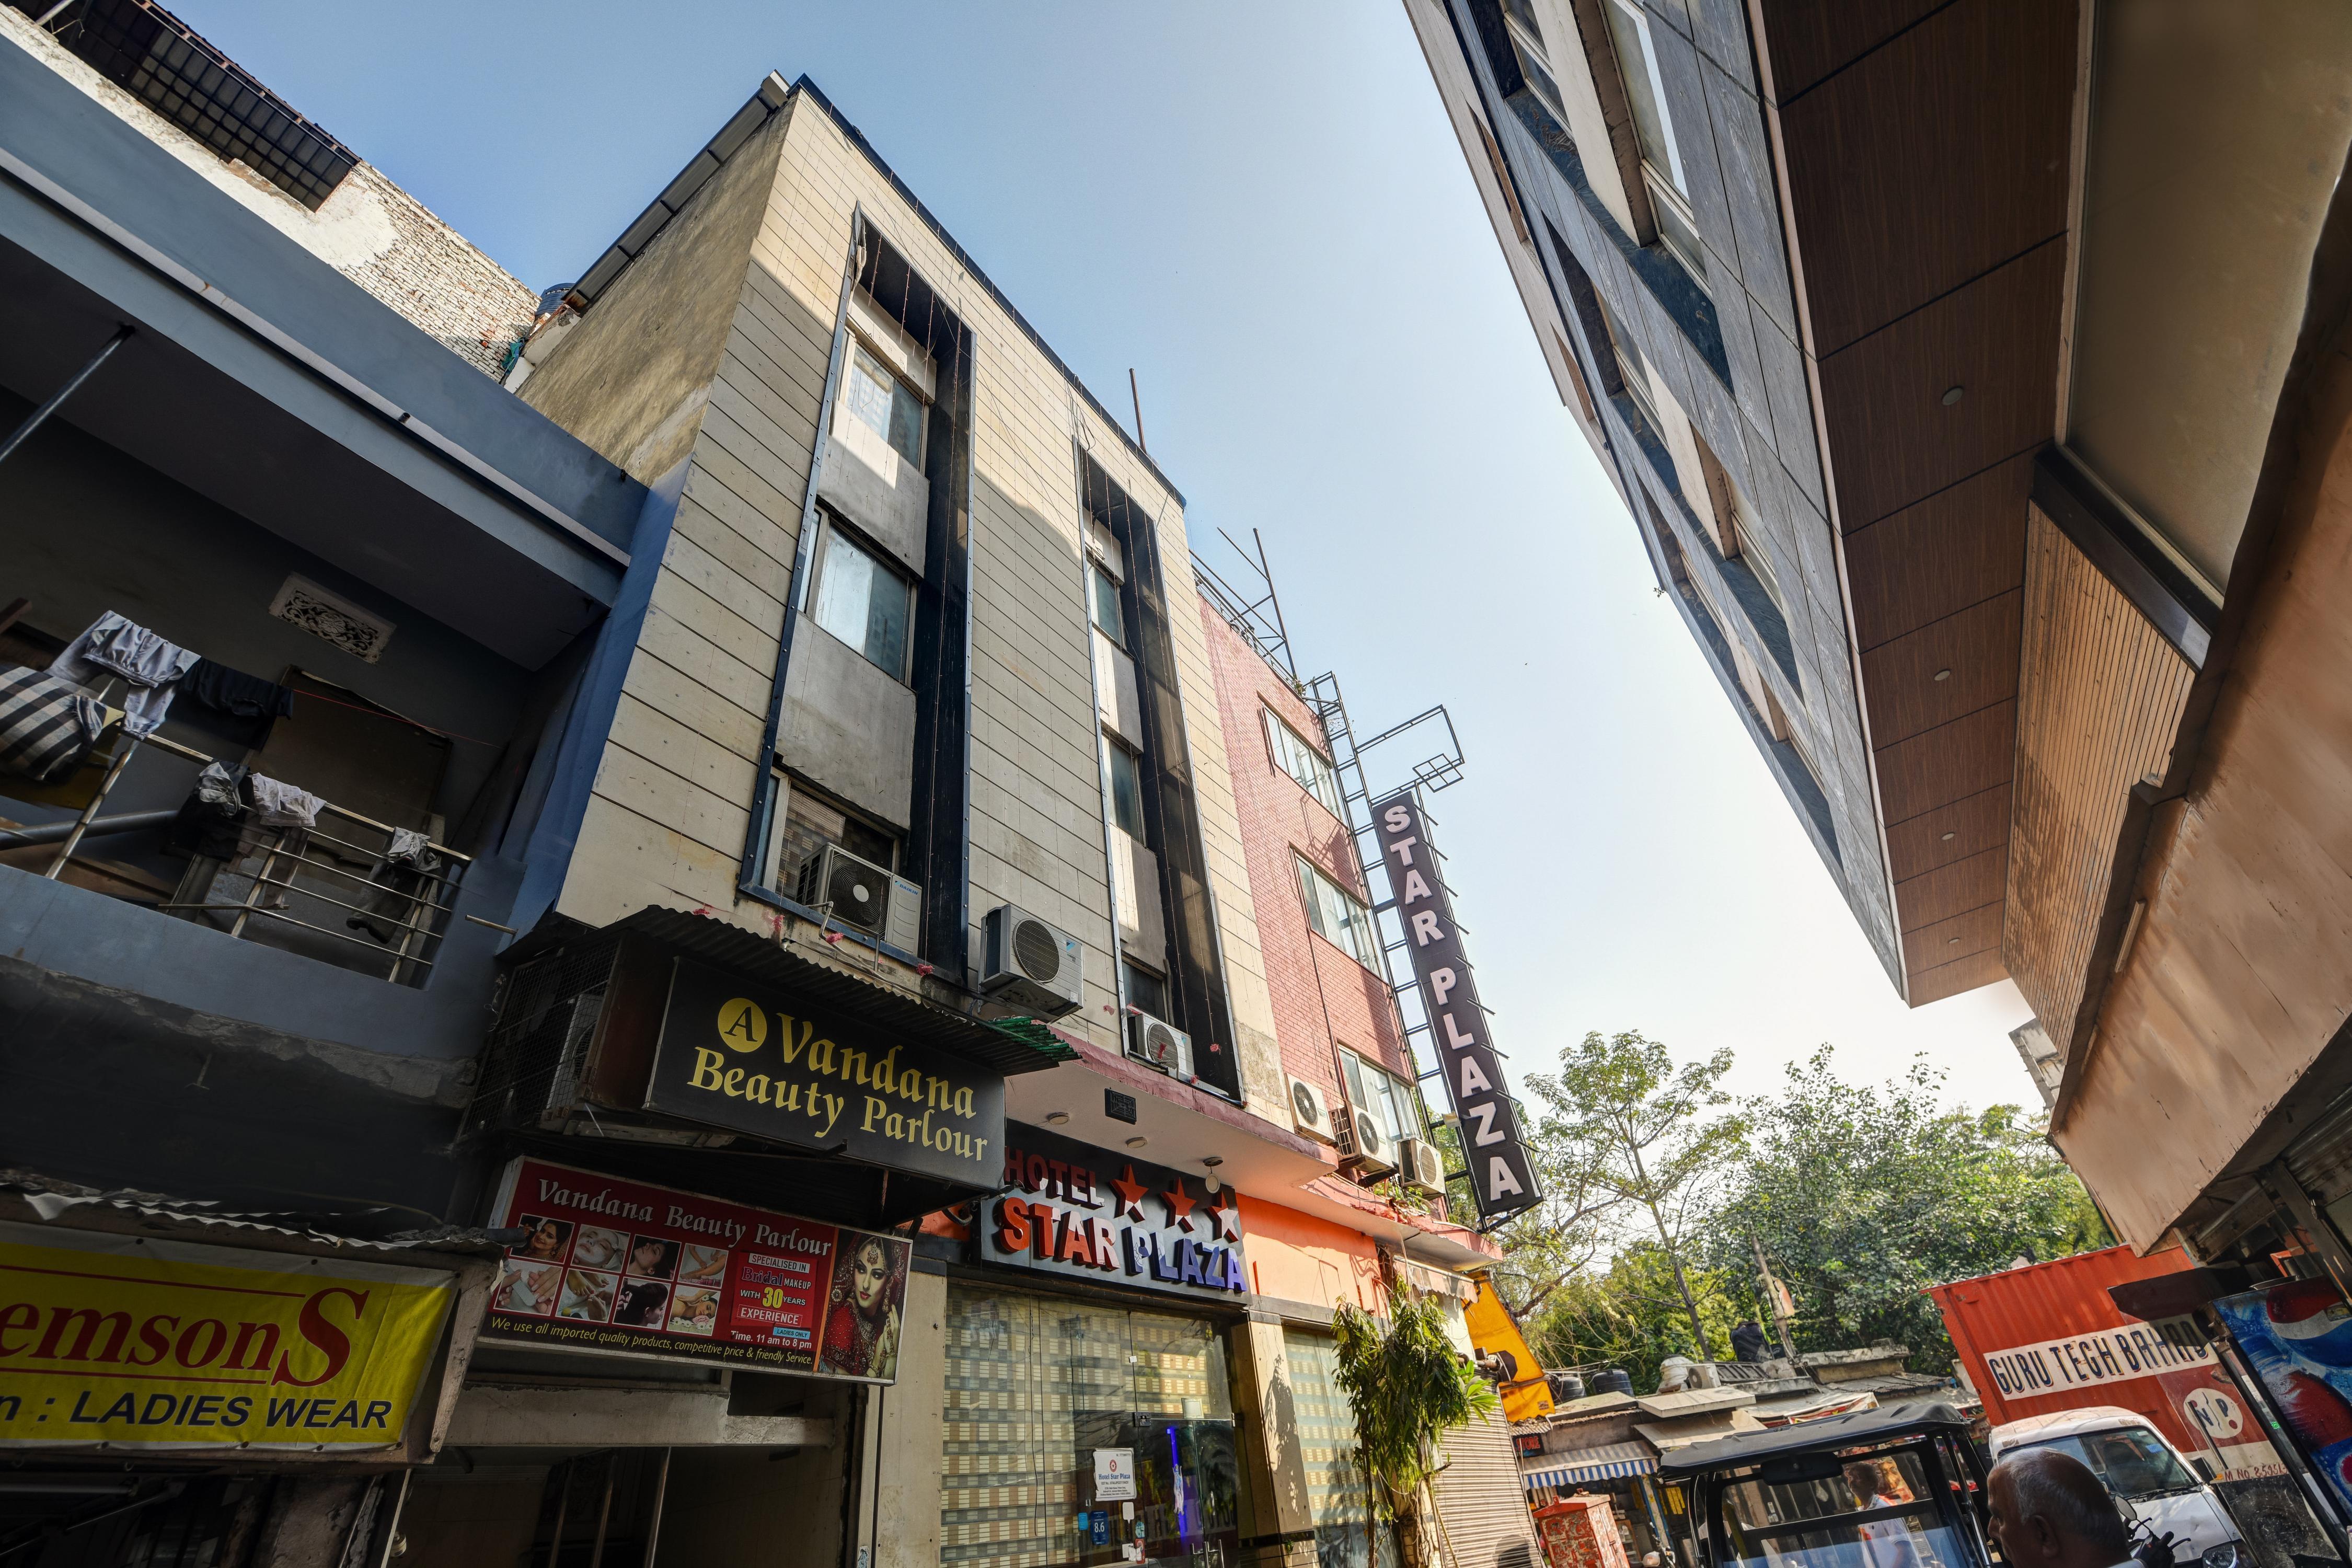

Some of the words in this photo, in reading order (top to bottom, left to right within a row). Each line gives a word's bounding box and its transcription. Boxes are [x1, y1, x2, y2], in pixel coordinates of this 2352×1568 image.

[900, 884, 918, 895] DAIKIN
[1385, 805, 1446, 948] STAR
[1430, 967, 1524, 1202] PLAZA
[724, 1006, 758, 1042] A
[776, 1012, 976, 1120] Vandana
[687, 1046, 844, 1138] Beauty
[860, 1096, 987, 1161] Parlour
[1004, 1146, 1105, 1207] HOTEL
[539, 1179, 653, 1222] Vandana
[664, 1205, 746, 1248] Beauty
[754, 1224, 832, 1255] Parlour
[752, 1254, 797, 1270] SPECIALISED
[799, 1263, 806, 1272] IN
[1000, 1196, 1121, 1269] STAR
[1122, 1226, 1247, 1292] PLAZA
[742, 1266, 784, 1286] Bridal
[784, 1278, 811, 1289] MAKEUP
[740, 1289, 761, 1299] WITH
[762, 1287, 783, 1308] 30
[783, 1296, 806, 1306] YEARS
[740, 1307, 799, 1324] EXPERIENCE
[492, 1317, 510, 1330] We
[513, 1323, 532, 1333] use
[535, 1323, 549, 1334] all
[550, 1324, 597, 1340] imported
[599, 1332, 630, 1347] quality
[631, 1335, 672, 1351] products,
[675, 1341, 722, 1354] competitive
[723, 1346, 744, 1358] price
[746, 1347, 754, 1358] &
[755, 1348, 784, 1364] friendly
[786, 1352, 812, 1364] Service.
[731, 1330, 753, 1342] Time.
[756, 1334, 765, 1343] 11
[782, 1338, 790, 1346] to
[792, 1339, 798, 1347] 8
[799, 1341, 812, 1350] pm
[1989, 1350, 2054, 1394] GURU
[2049, 1337, 2125, 1383] TECH
[69, 1390, 253, 1427] LADIES
[266, 1398, 393, 1429] WEAR
[1516, 1436, 1541, 1451] STORE
[1094, 1521, 1105, 1533] 8.6
